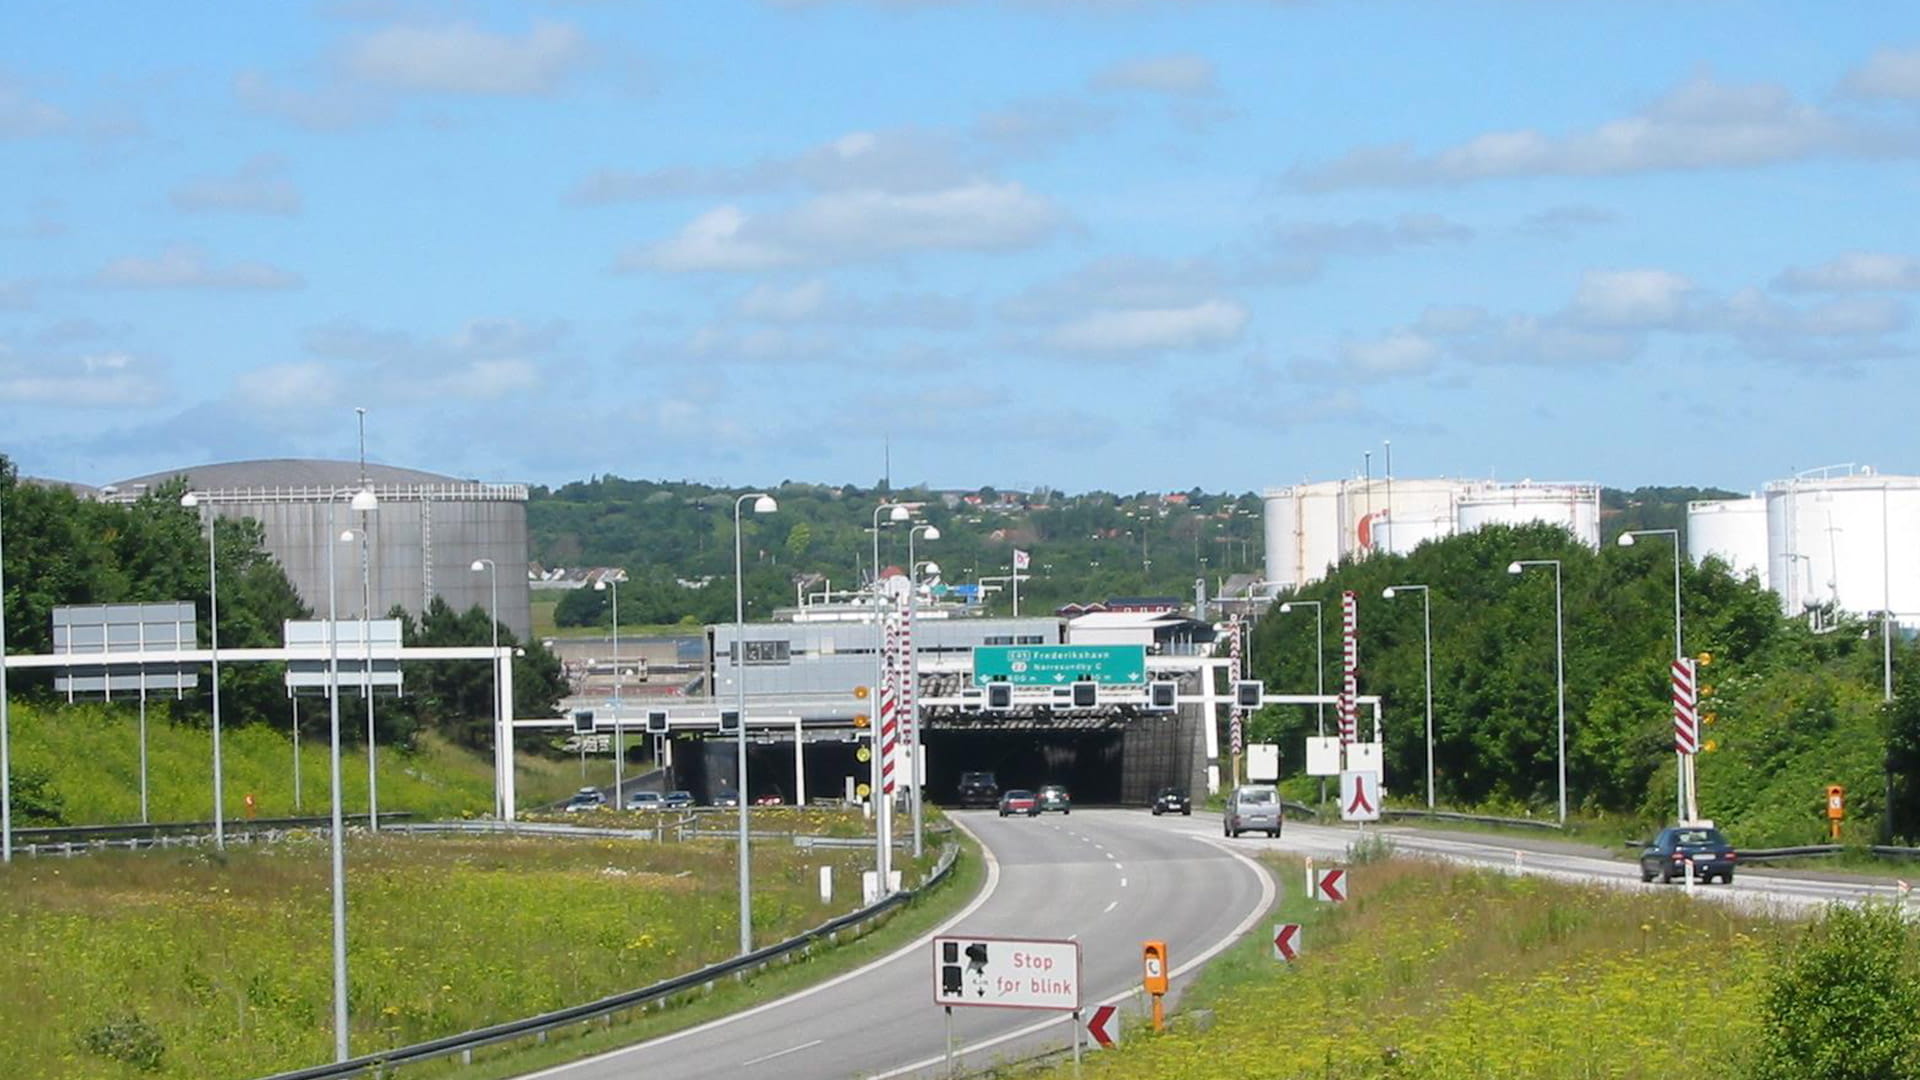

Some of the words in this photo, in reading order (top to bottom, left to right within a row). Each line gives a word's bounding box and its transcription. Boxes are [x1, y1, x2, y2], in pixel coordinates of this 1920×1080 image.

[1033, 651, 1110, 659] Frederikshavn
[1095, 662, 1102, 670] C
[1013, 953, 1053, 970] Stop
[997, 977, 1020, 993] for
[1031, 979, 1072, 994] blink
